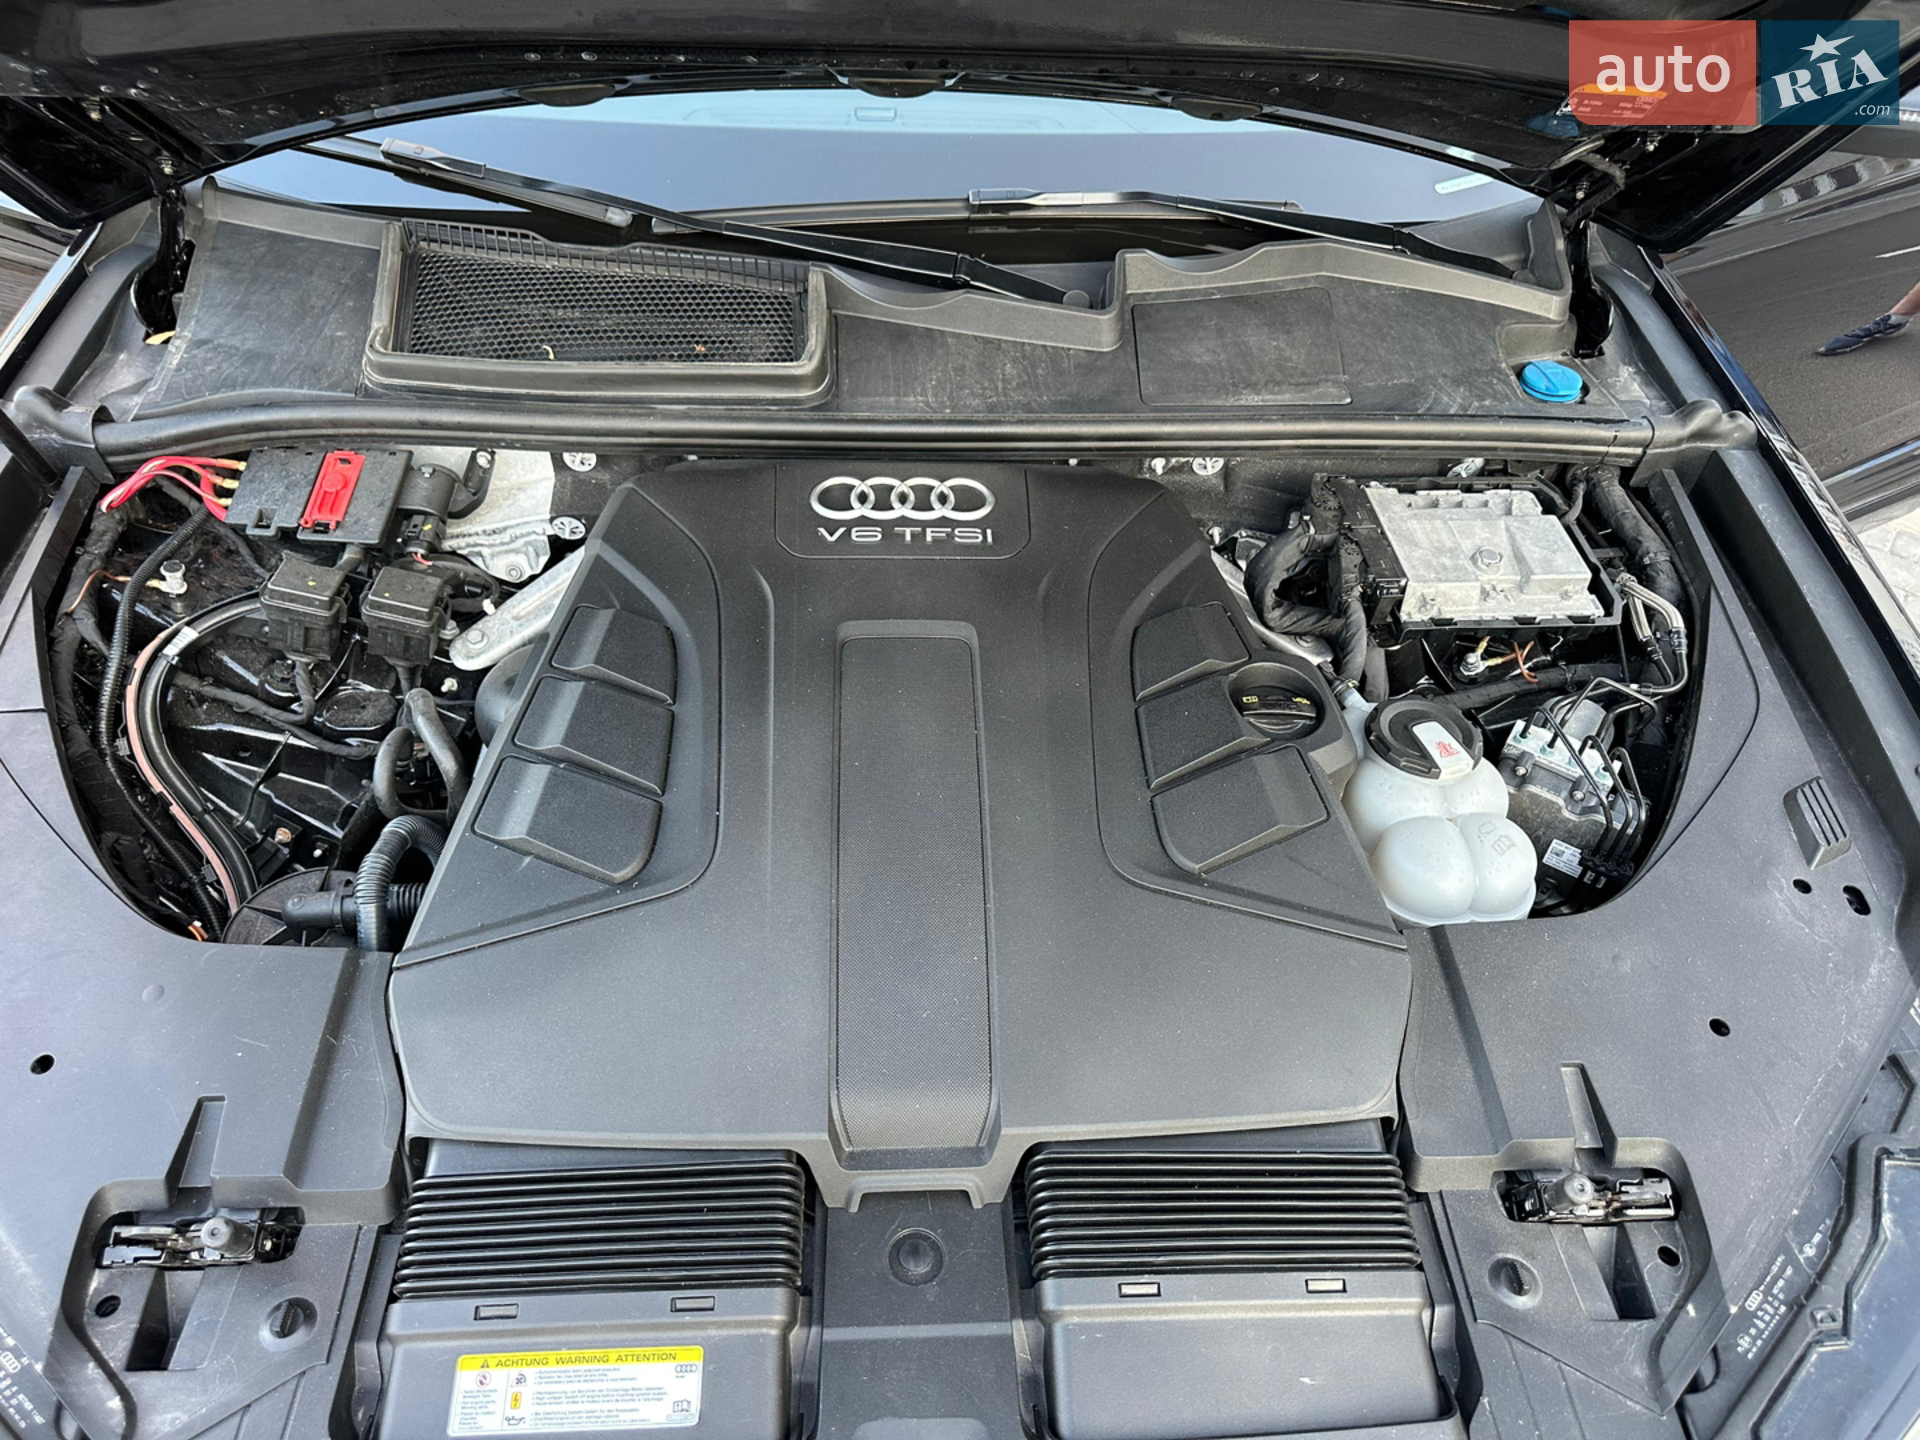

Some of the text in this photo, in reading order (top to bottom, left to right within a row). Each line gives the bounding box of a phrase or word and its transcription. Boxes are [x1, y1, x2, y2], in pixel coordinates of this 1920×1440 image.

[816, 527, 993, 546] V6 TFSI
[496, 1352, 677, 1367] ACHTUNG WARNING ATTENTION
